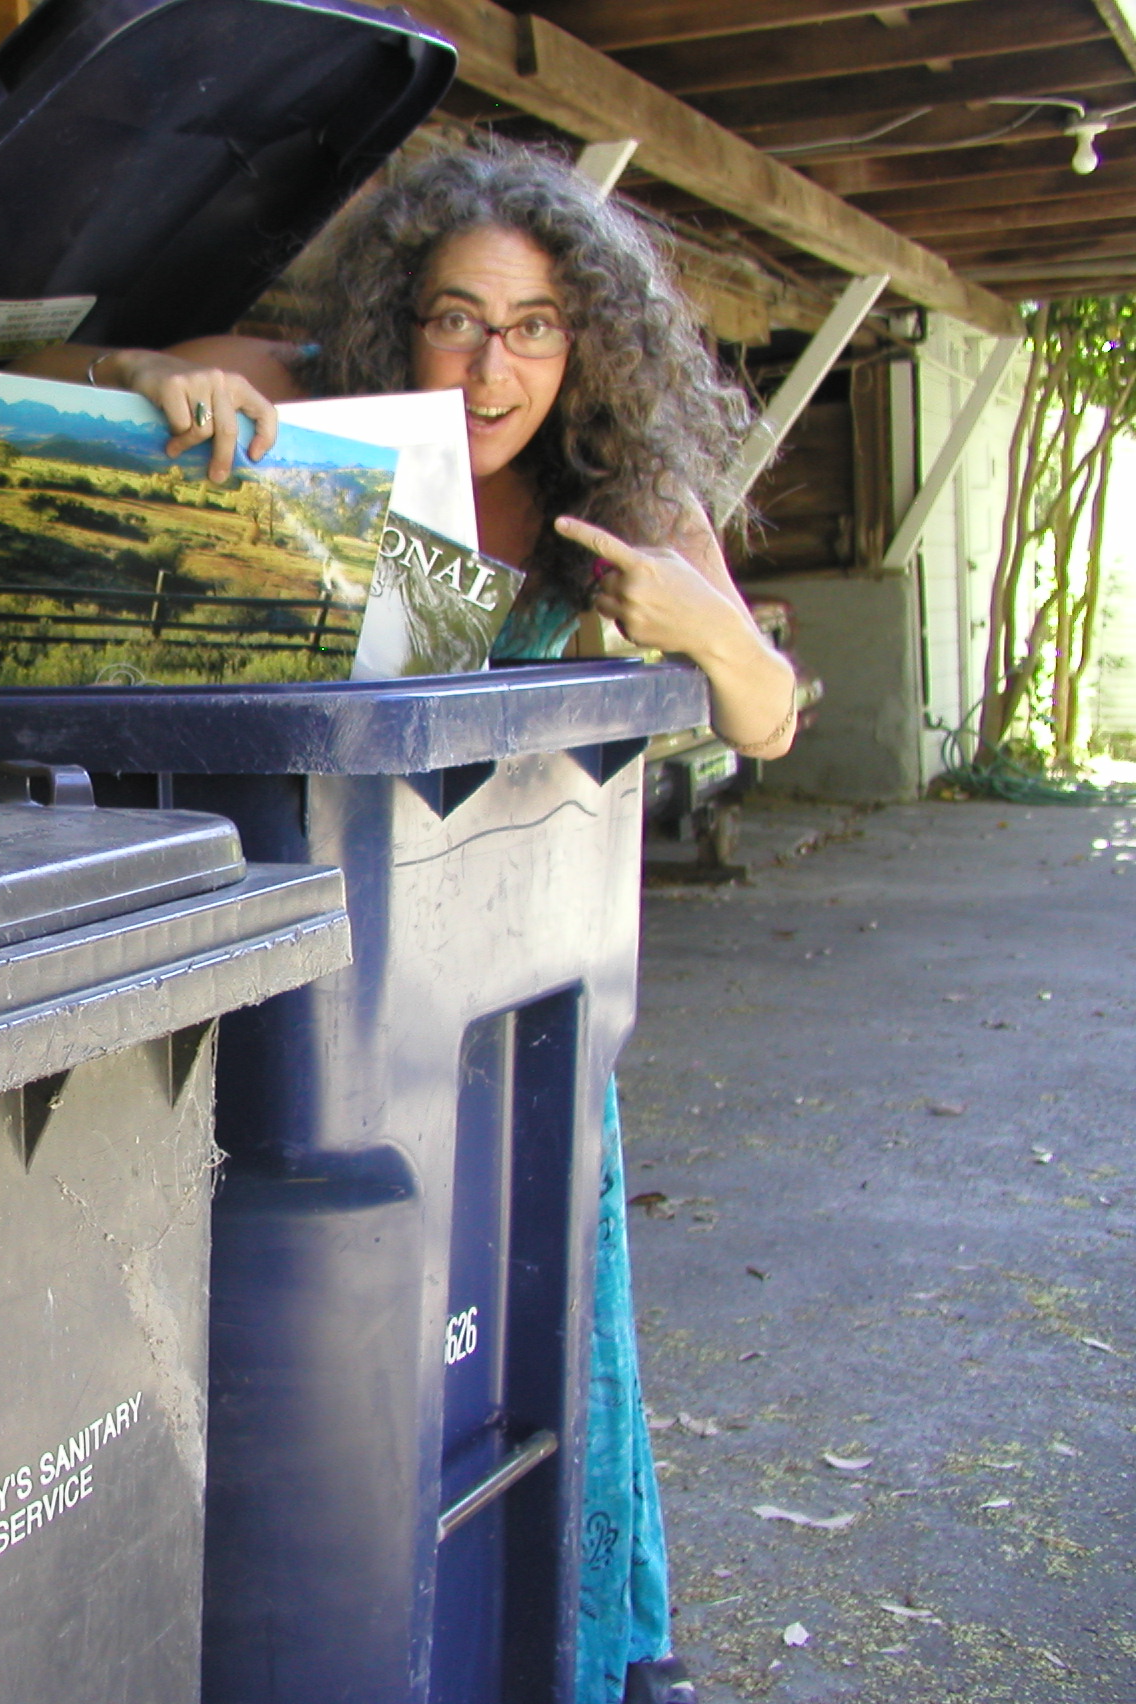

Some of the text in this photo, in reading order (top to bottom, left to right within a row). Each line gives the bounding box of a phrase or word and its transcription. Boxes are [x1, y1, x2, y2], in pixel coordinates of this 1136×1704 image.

[379, 526, 496, 611] ONAL
[444, 1306, 478, 1365] 626
[39, 1391, 142, 1485] SANITARY
